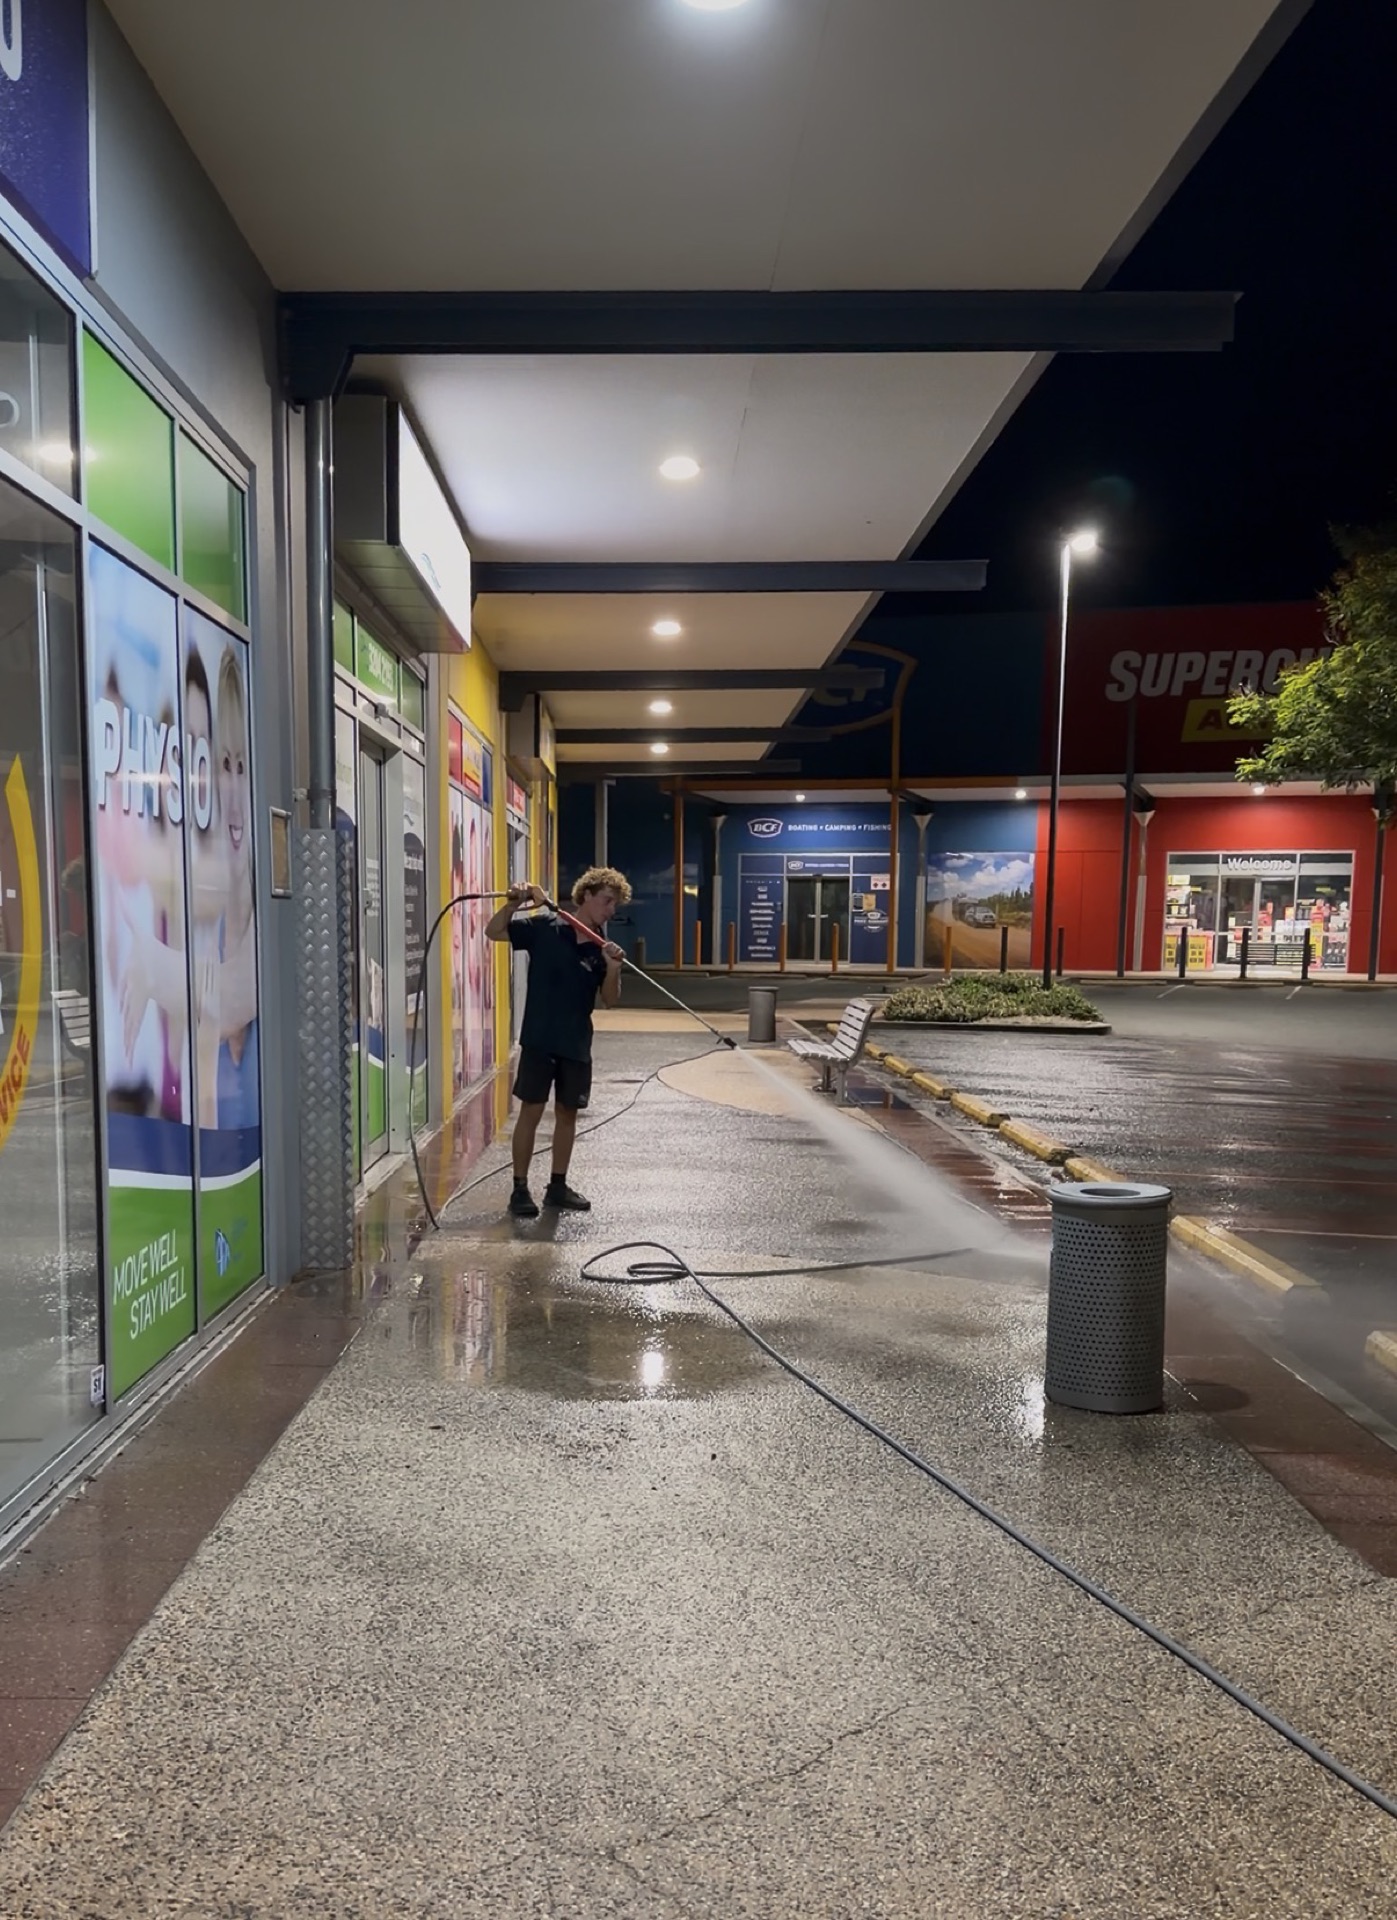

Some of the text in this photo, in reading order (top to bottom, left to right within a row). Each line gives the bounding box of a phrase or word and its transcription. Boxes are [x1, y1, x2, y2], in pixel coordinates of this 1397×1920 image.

[1104, 648, 1334, 701] SUPERC
[94, 697, 211, 830] PHYSIO
[1228, 857, 1291, 870] Welcome
[0, 1024, 30, 1126] VICE
[113, 1246, 148, 1305] MOVE
[149, 1229, 178, 1278] WELL
[130, 1266, 187, 1340] STAY WELL
